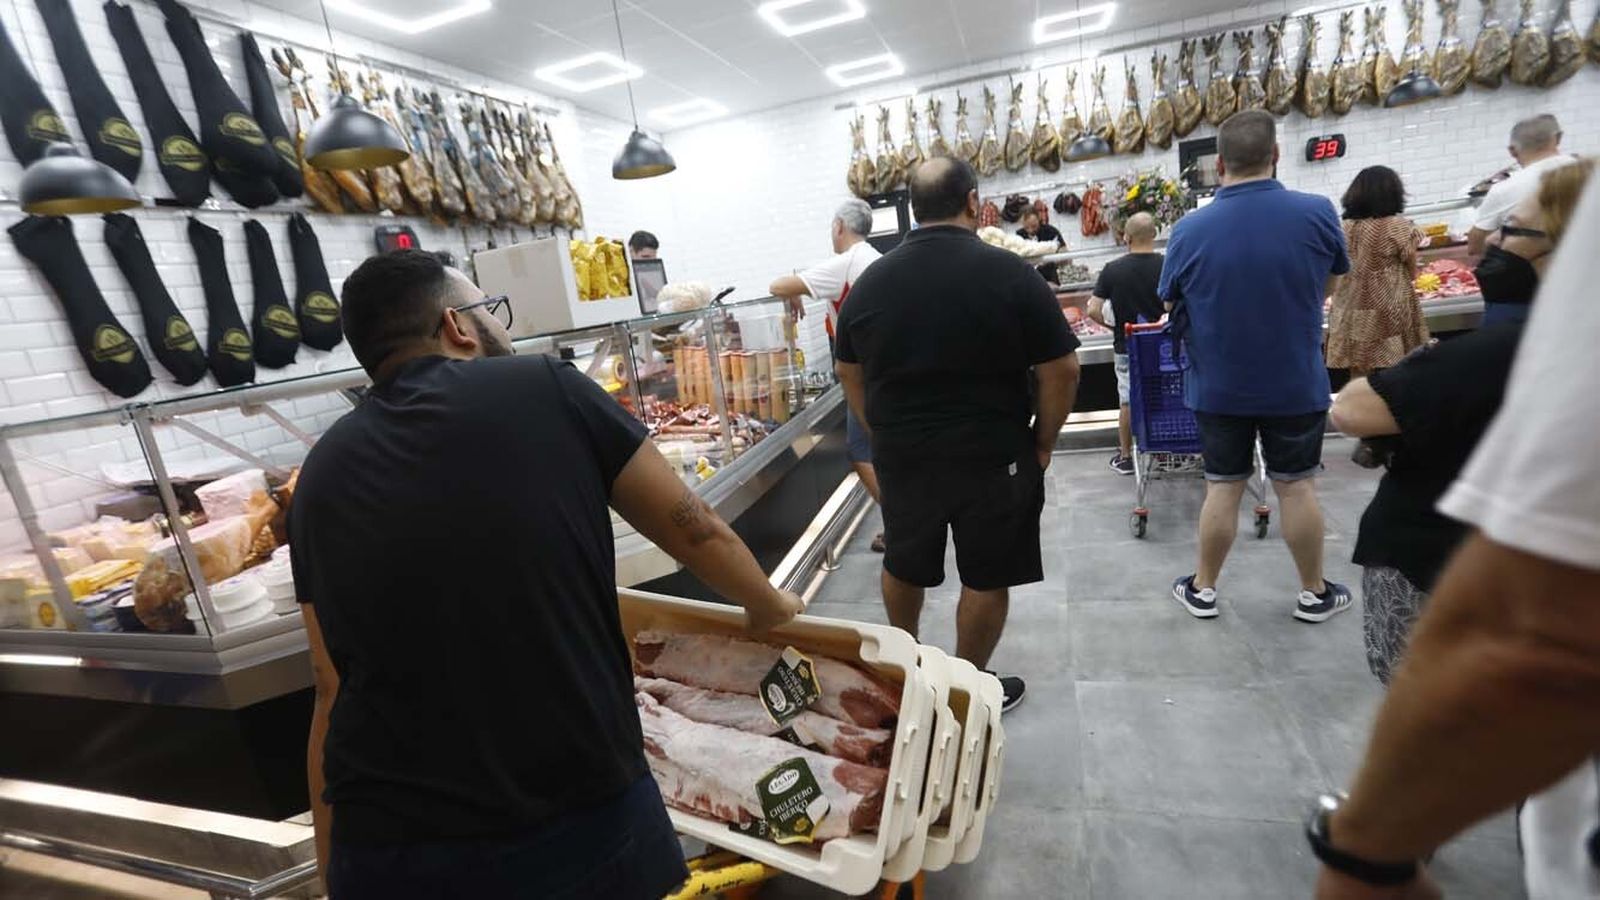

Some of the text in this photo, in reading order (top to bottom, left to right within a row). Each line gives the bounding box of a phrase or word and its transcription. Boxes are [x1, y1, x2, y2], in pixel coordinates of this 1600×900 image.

[1314, 140, 1338, 158] 39
[769, 771, 798, 791] LEGADO
[769, 786, 814, 818] CHULETERO
